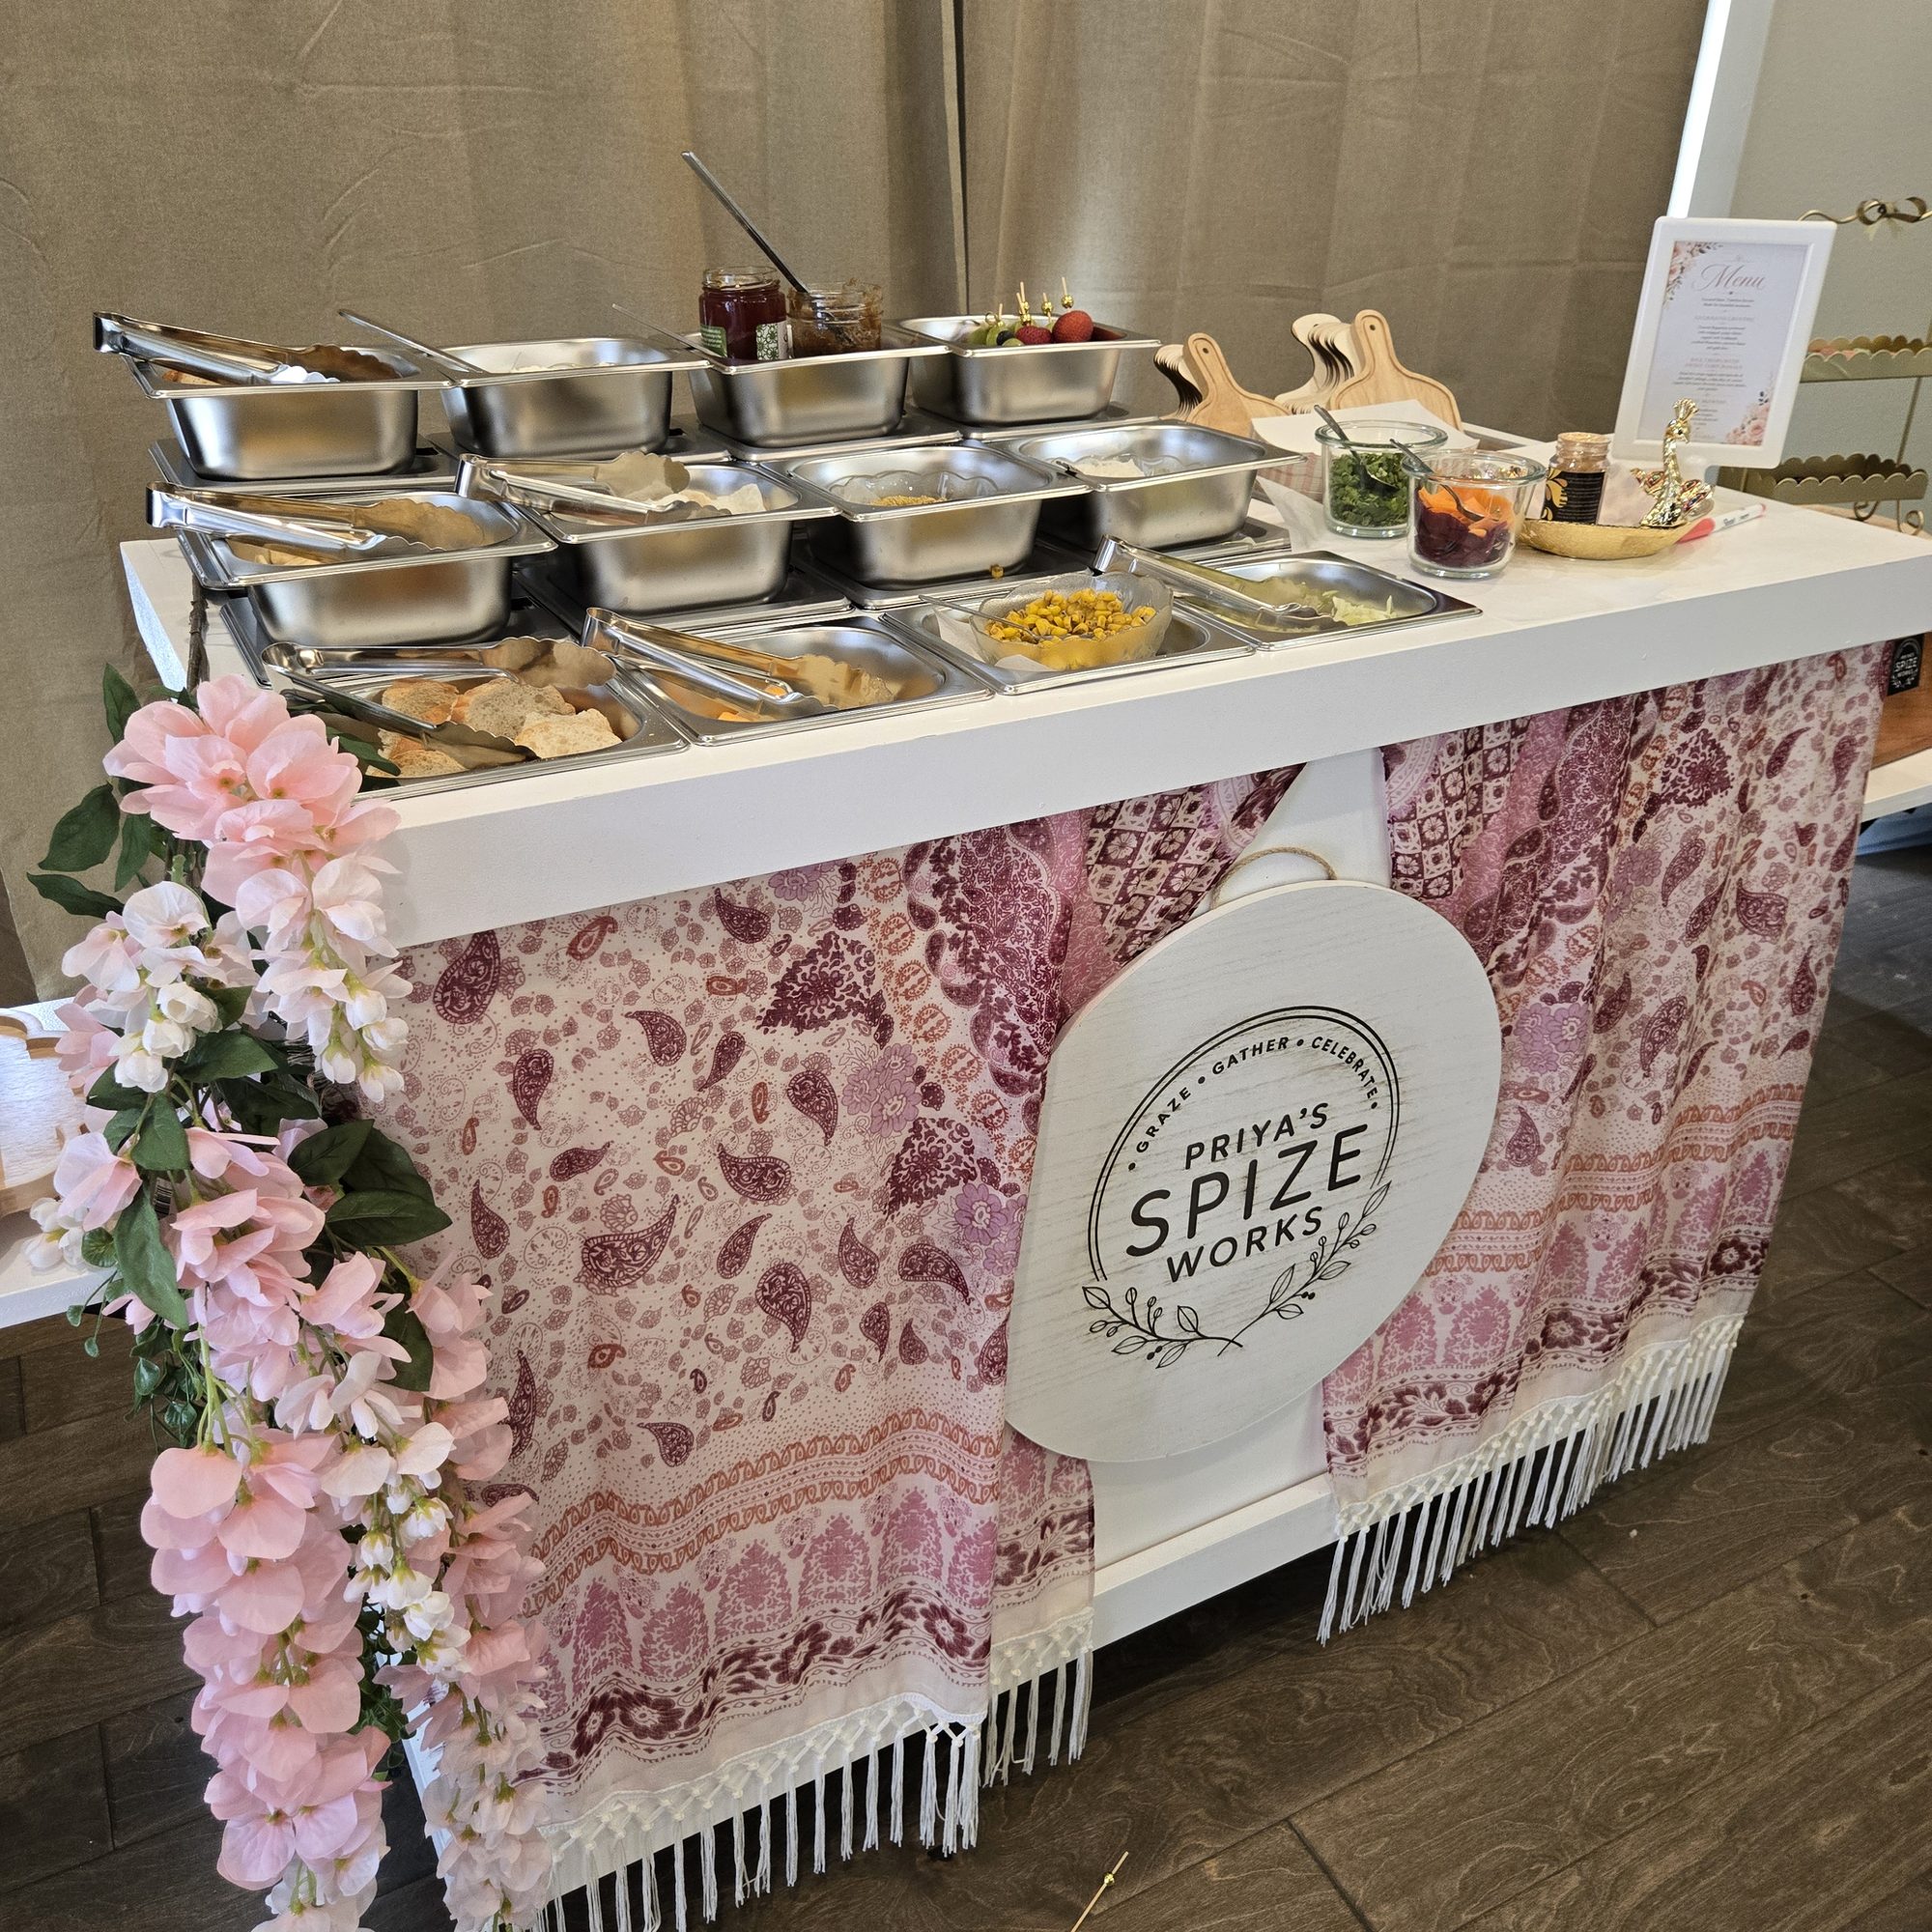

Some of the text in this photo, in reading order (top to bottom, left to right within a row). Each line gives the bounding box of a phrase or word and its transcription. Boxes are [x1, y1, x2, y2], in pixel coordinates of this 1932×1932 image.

[1698, 264, 1766, 290] Menu
[1136, 1036, 1378, 1153] GRAZE GATHER CELEBRATE
[1184, 1102, 1328, 1170] PRIYA'S
[1125, 1123, 1368, 1257] SPIZE
[1166, 1206, 1322, 1283] WORKS
